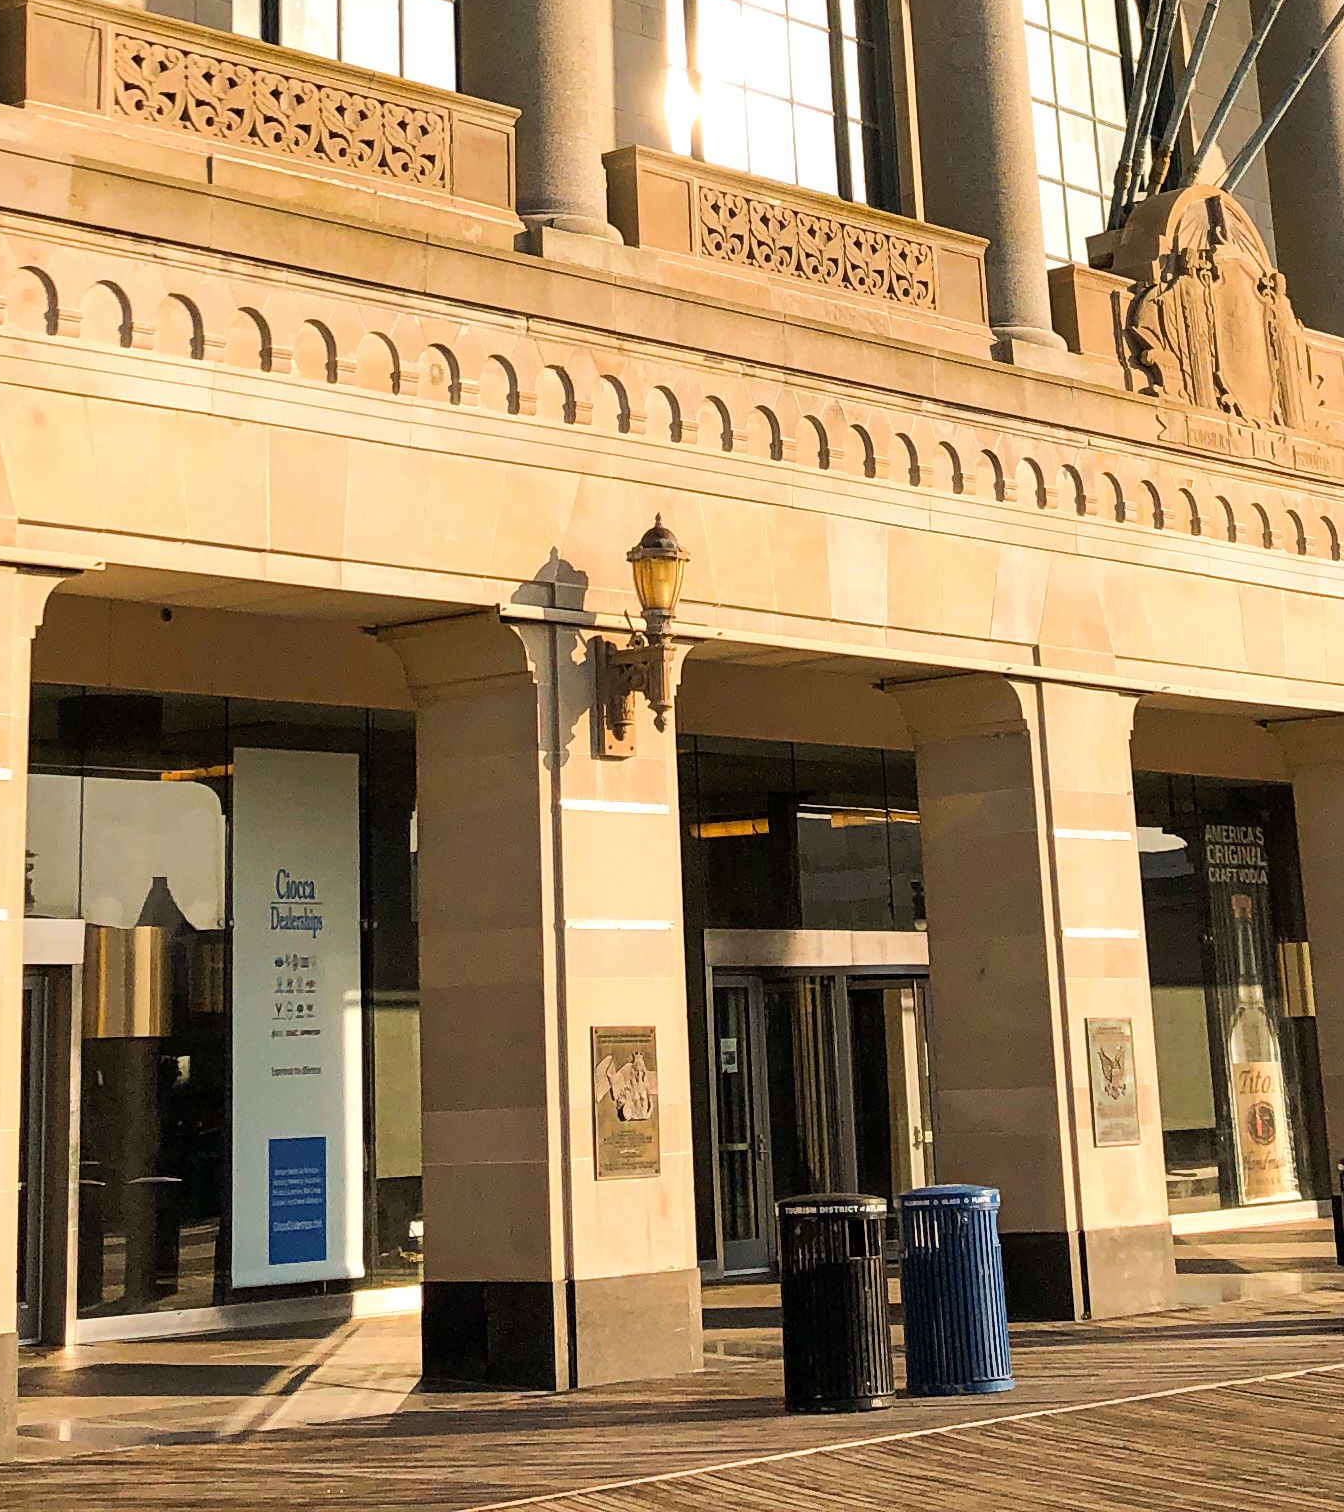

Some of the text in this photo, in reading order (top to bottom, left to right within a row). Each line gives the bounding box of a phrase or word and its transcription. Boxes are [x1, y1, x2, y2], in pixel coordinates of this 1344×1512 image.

[1206, 844, 1267, 866] ORIGINAL
[275, 868, 316, 900] Ciocca
[1208, 867, 1238, 882] CRAFT
[270, 906, 324, 938] Dealerships
[819, 1205, 859, 1214] DISTRICT
